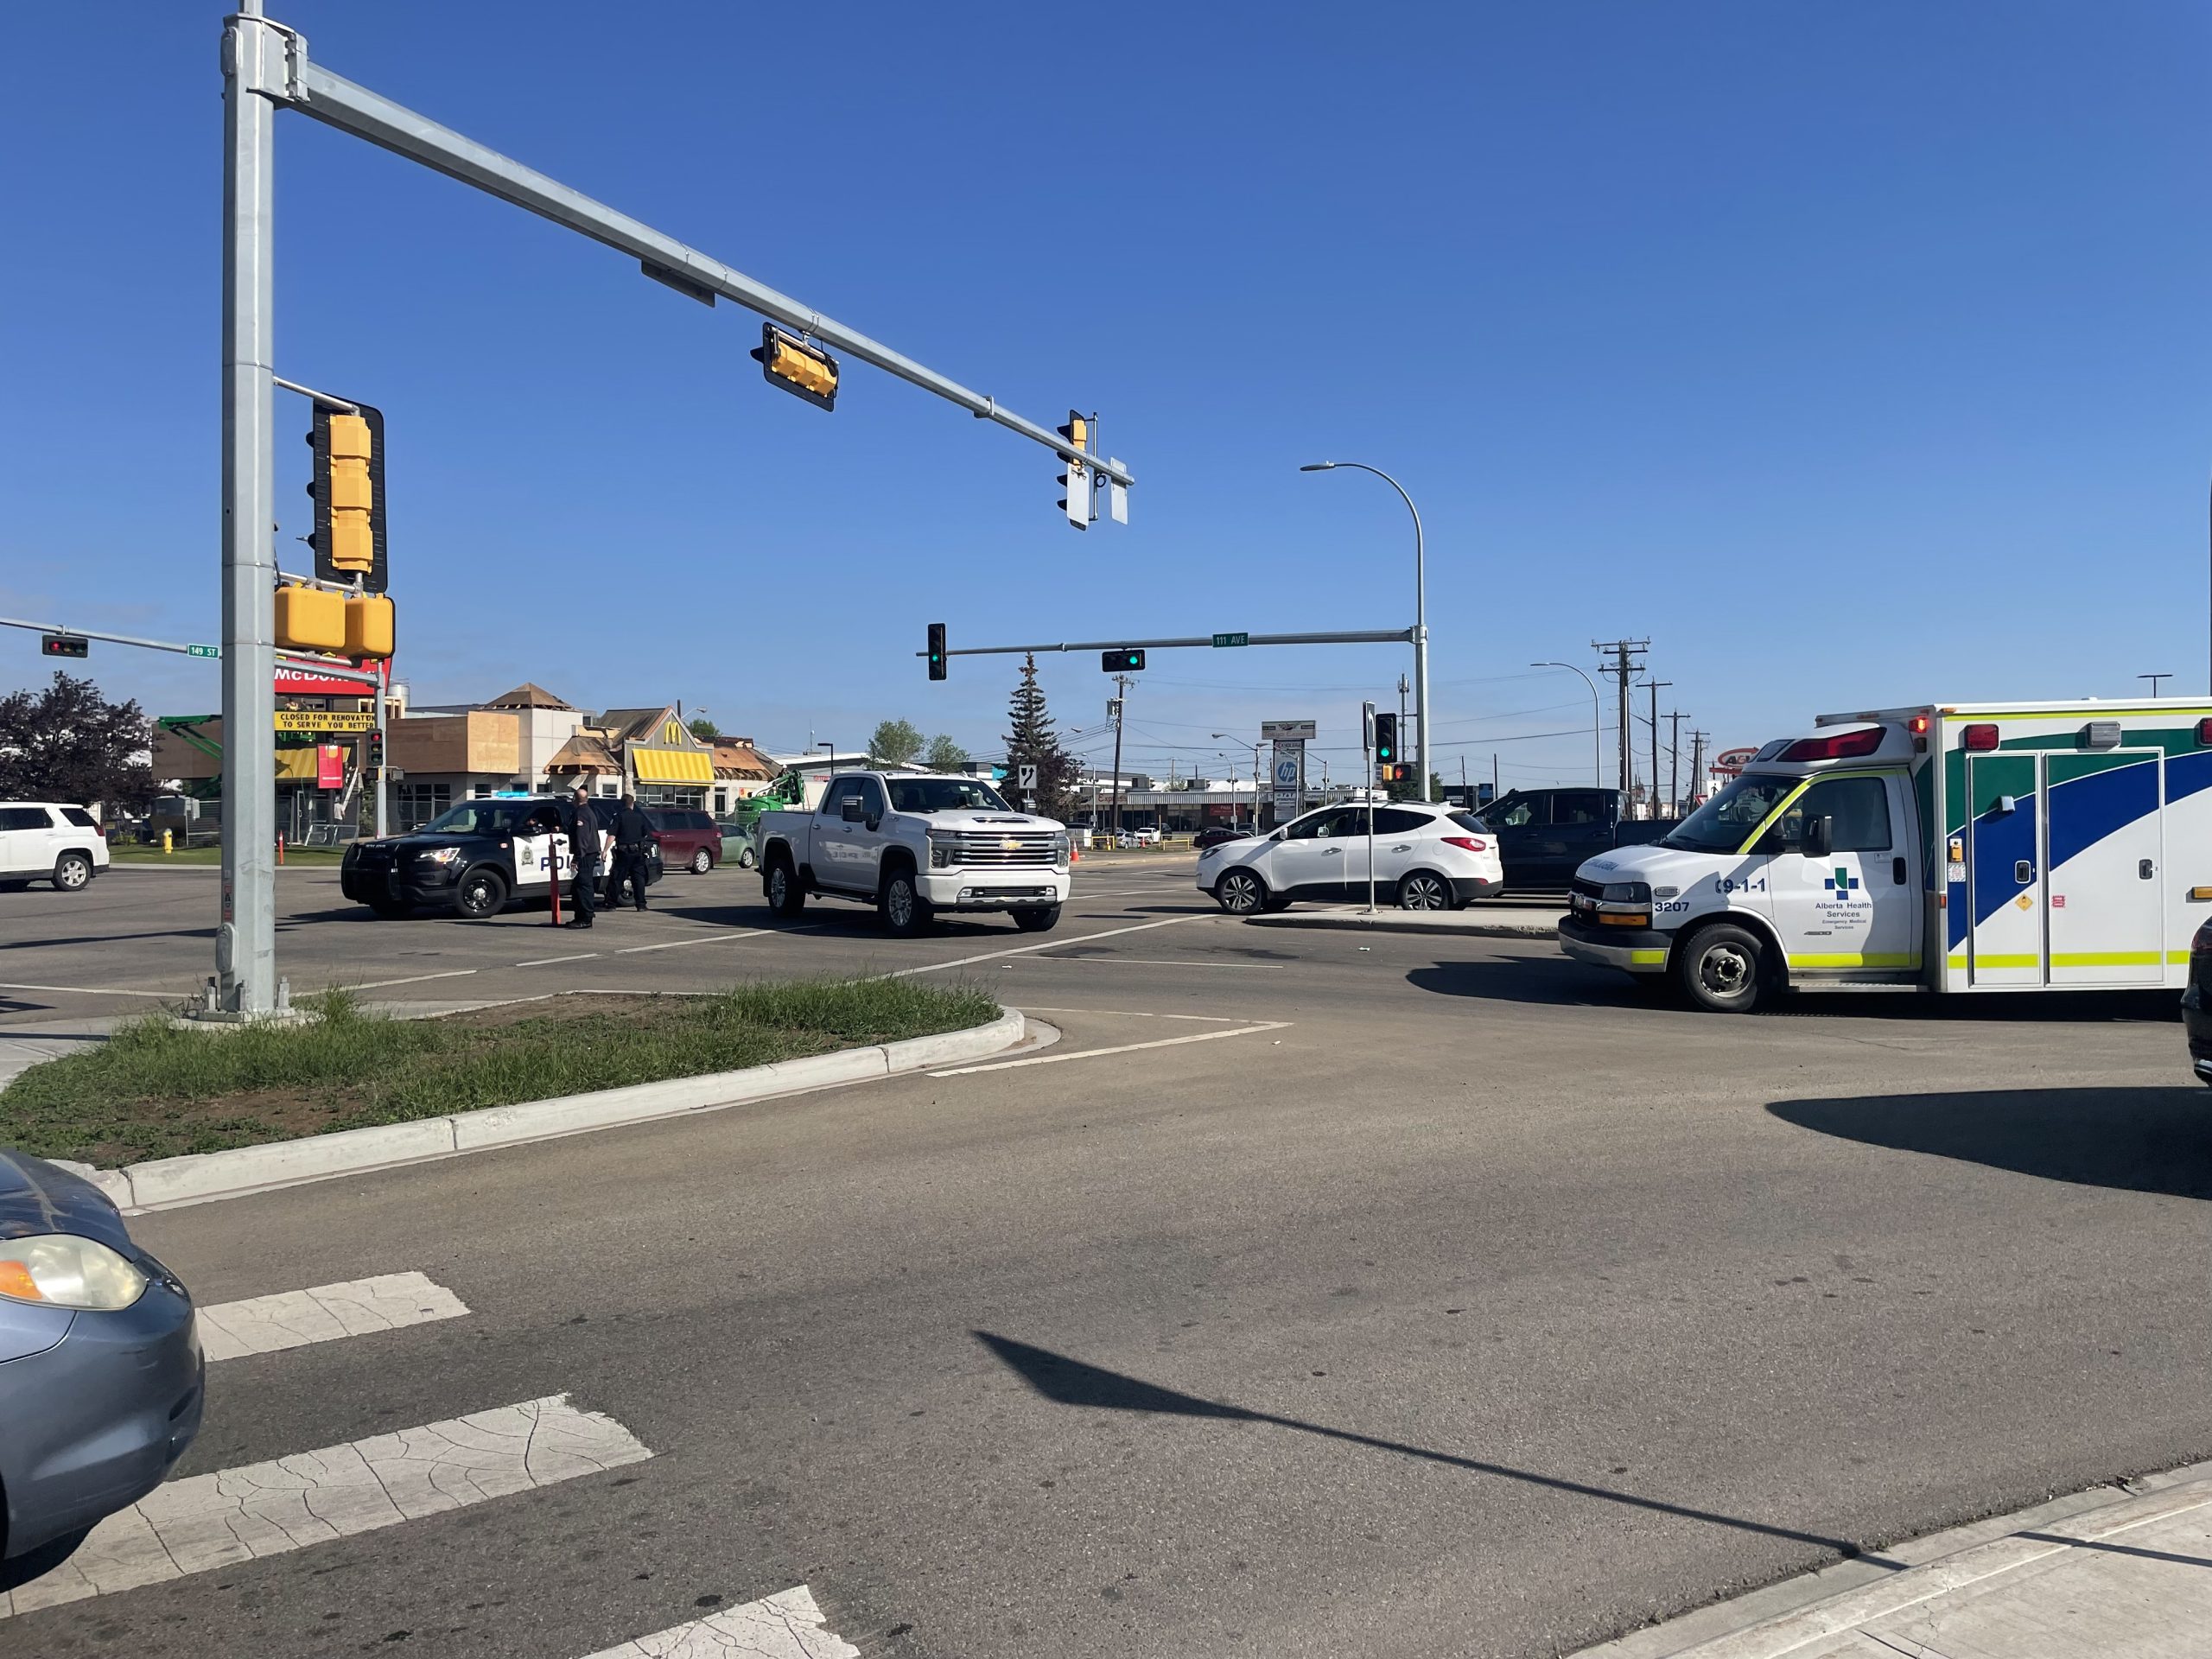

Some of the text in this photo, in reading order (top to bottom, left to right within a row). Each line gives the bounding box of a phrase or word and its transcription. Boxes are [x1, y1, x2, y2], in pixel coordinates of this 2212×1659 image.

[1217, 635, 1245, 645] 111 AVE
[191, 646, 203, 655] 149
[1280, 762, 1296, 782] hp
[1098, 793, 1128, 804] Expss
[1655, 902, 1690, 912] 3207
